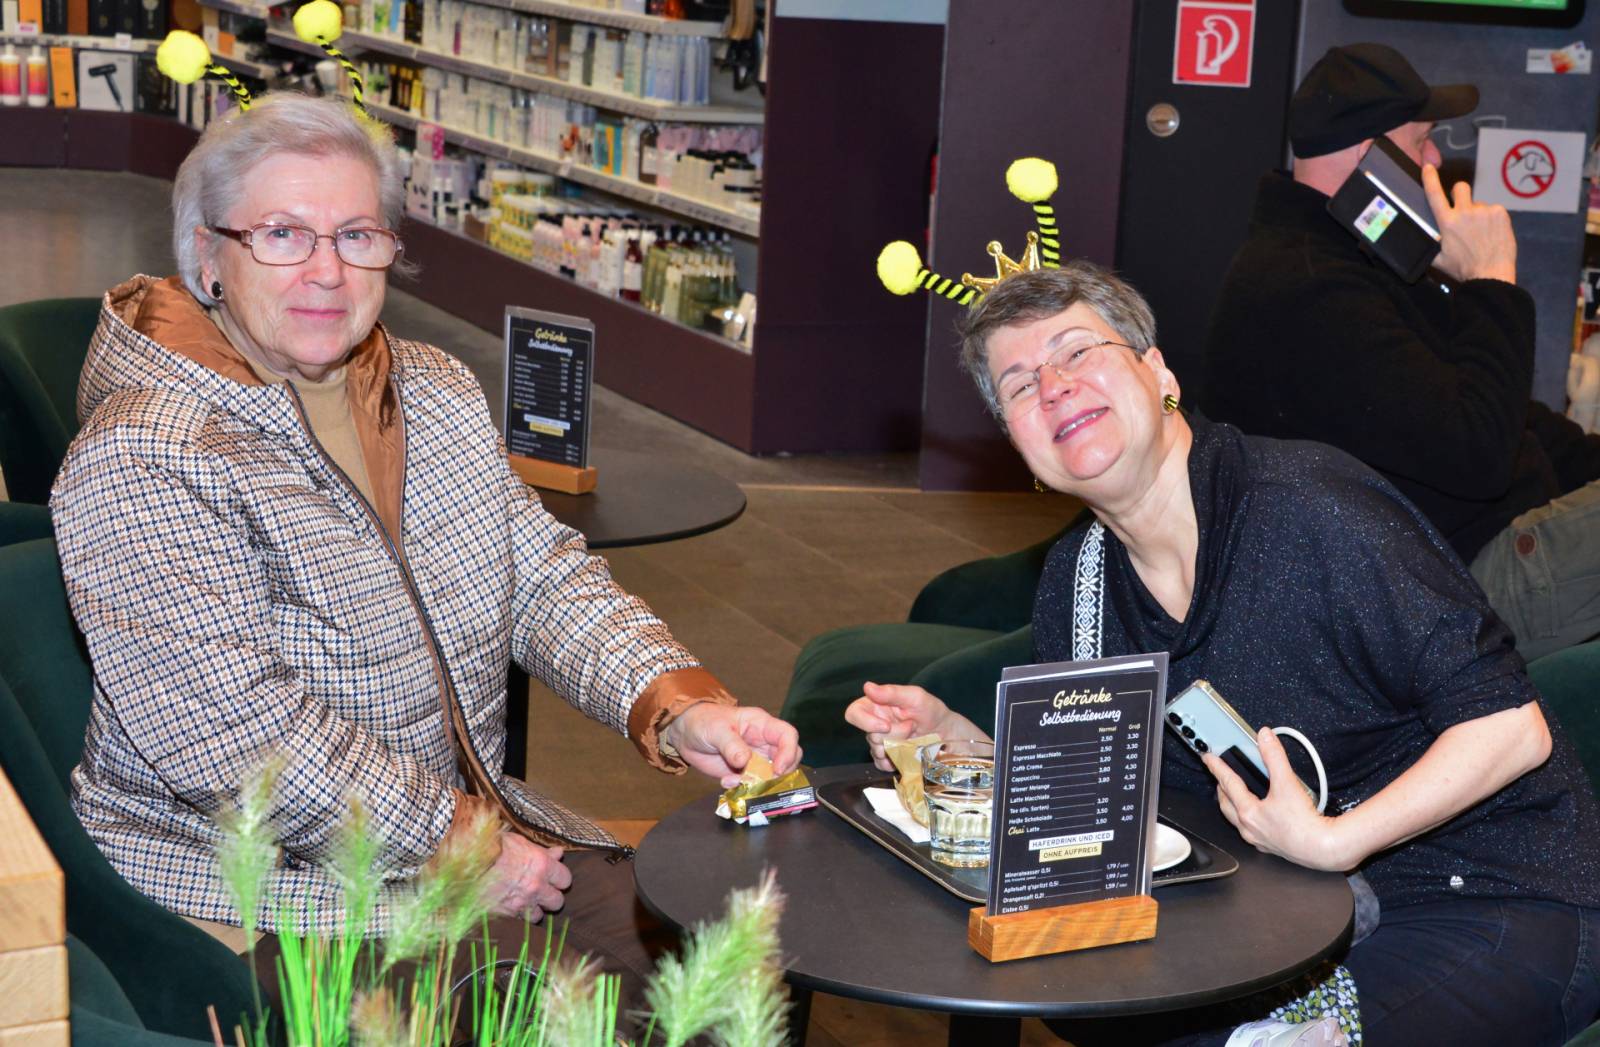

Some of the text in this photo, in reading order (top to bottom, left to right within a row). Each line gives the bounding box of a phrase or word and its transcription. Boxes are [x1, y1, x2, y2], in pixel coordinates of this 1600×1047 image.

[1053, 687, 1113, 709] Getränke
[1040, 709, 1121, 726] Selbstbedienung
[1024, 814, 1053, 823] Schokolade
[1008, 825, 1025, 836] Chai
[1032, 836, 1077, 847] HAFERDRINK
[1078, 834, 1094, 842] UND
[1043, 846, 1098, 858] OHNE AUFPREIS
[1004, 870, 1040, 878] Mineralwasser
[1004, 884, 1026, 894] Apfelsaft
[1002, 894, 1034, 904] Orangensaft
